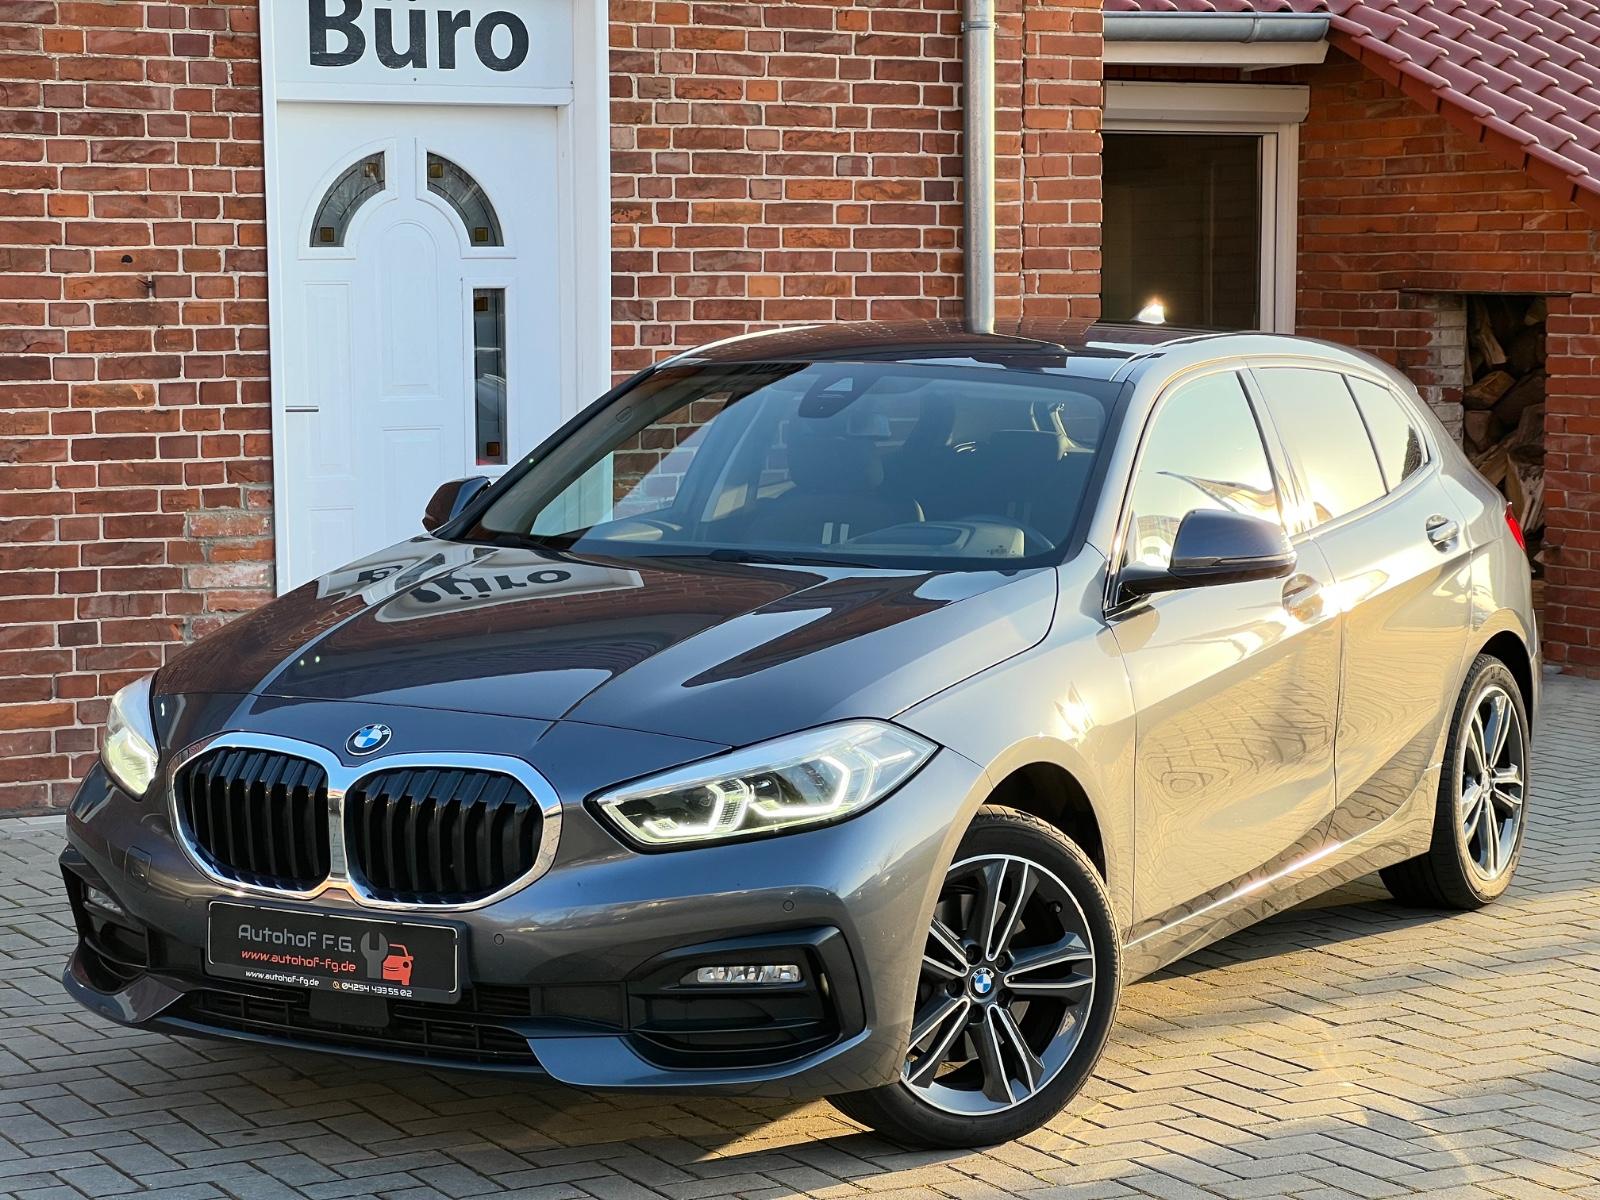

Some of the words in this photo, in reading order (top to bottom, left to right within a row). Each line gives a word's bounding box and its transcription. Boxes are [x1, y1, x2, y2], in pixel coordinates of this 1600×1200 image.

[308, 0, 530, 72] Büro
[238, 924, 317, 948] Autohof
[322, 934, 356, 953] F.G.
[241, 950, 357, 973] www.autohof-fg.de
[245, 970, 320, 987] www.autohof-fg.de
[341, 982, 370, 992] 04254
[399, 988, 413, 998] 02
